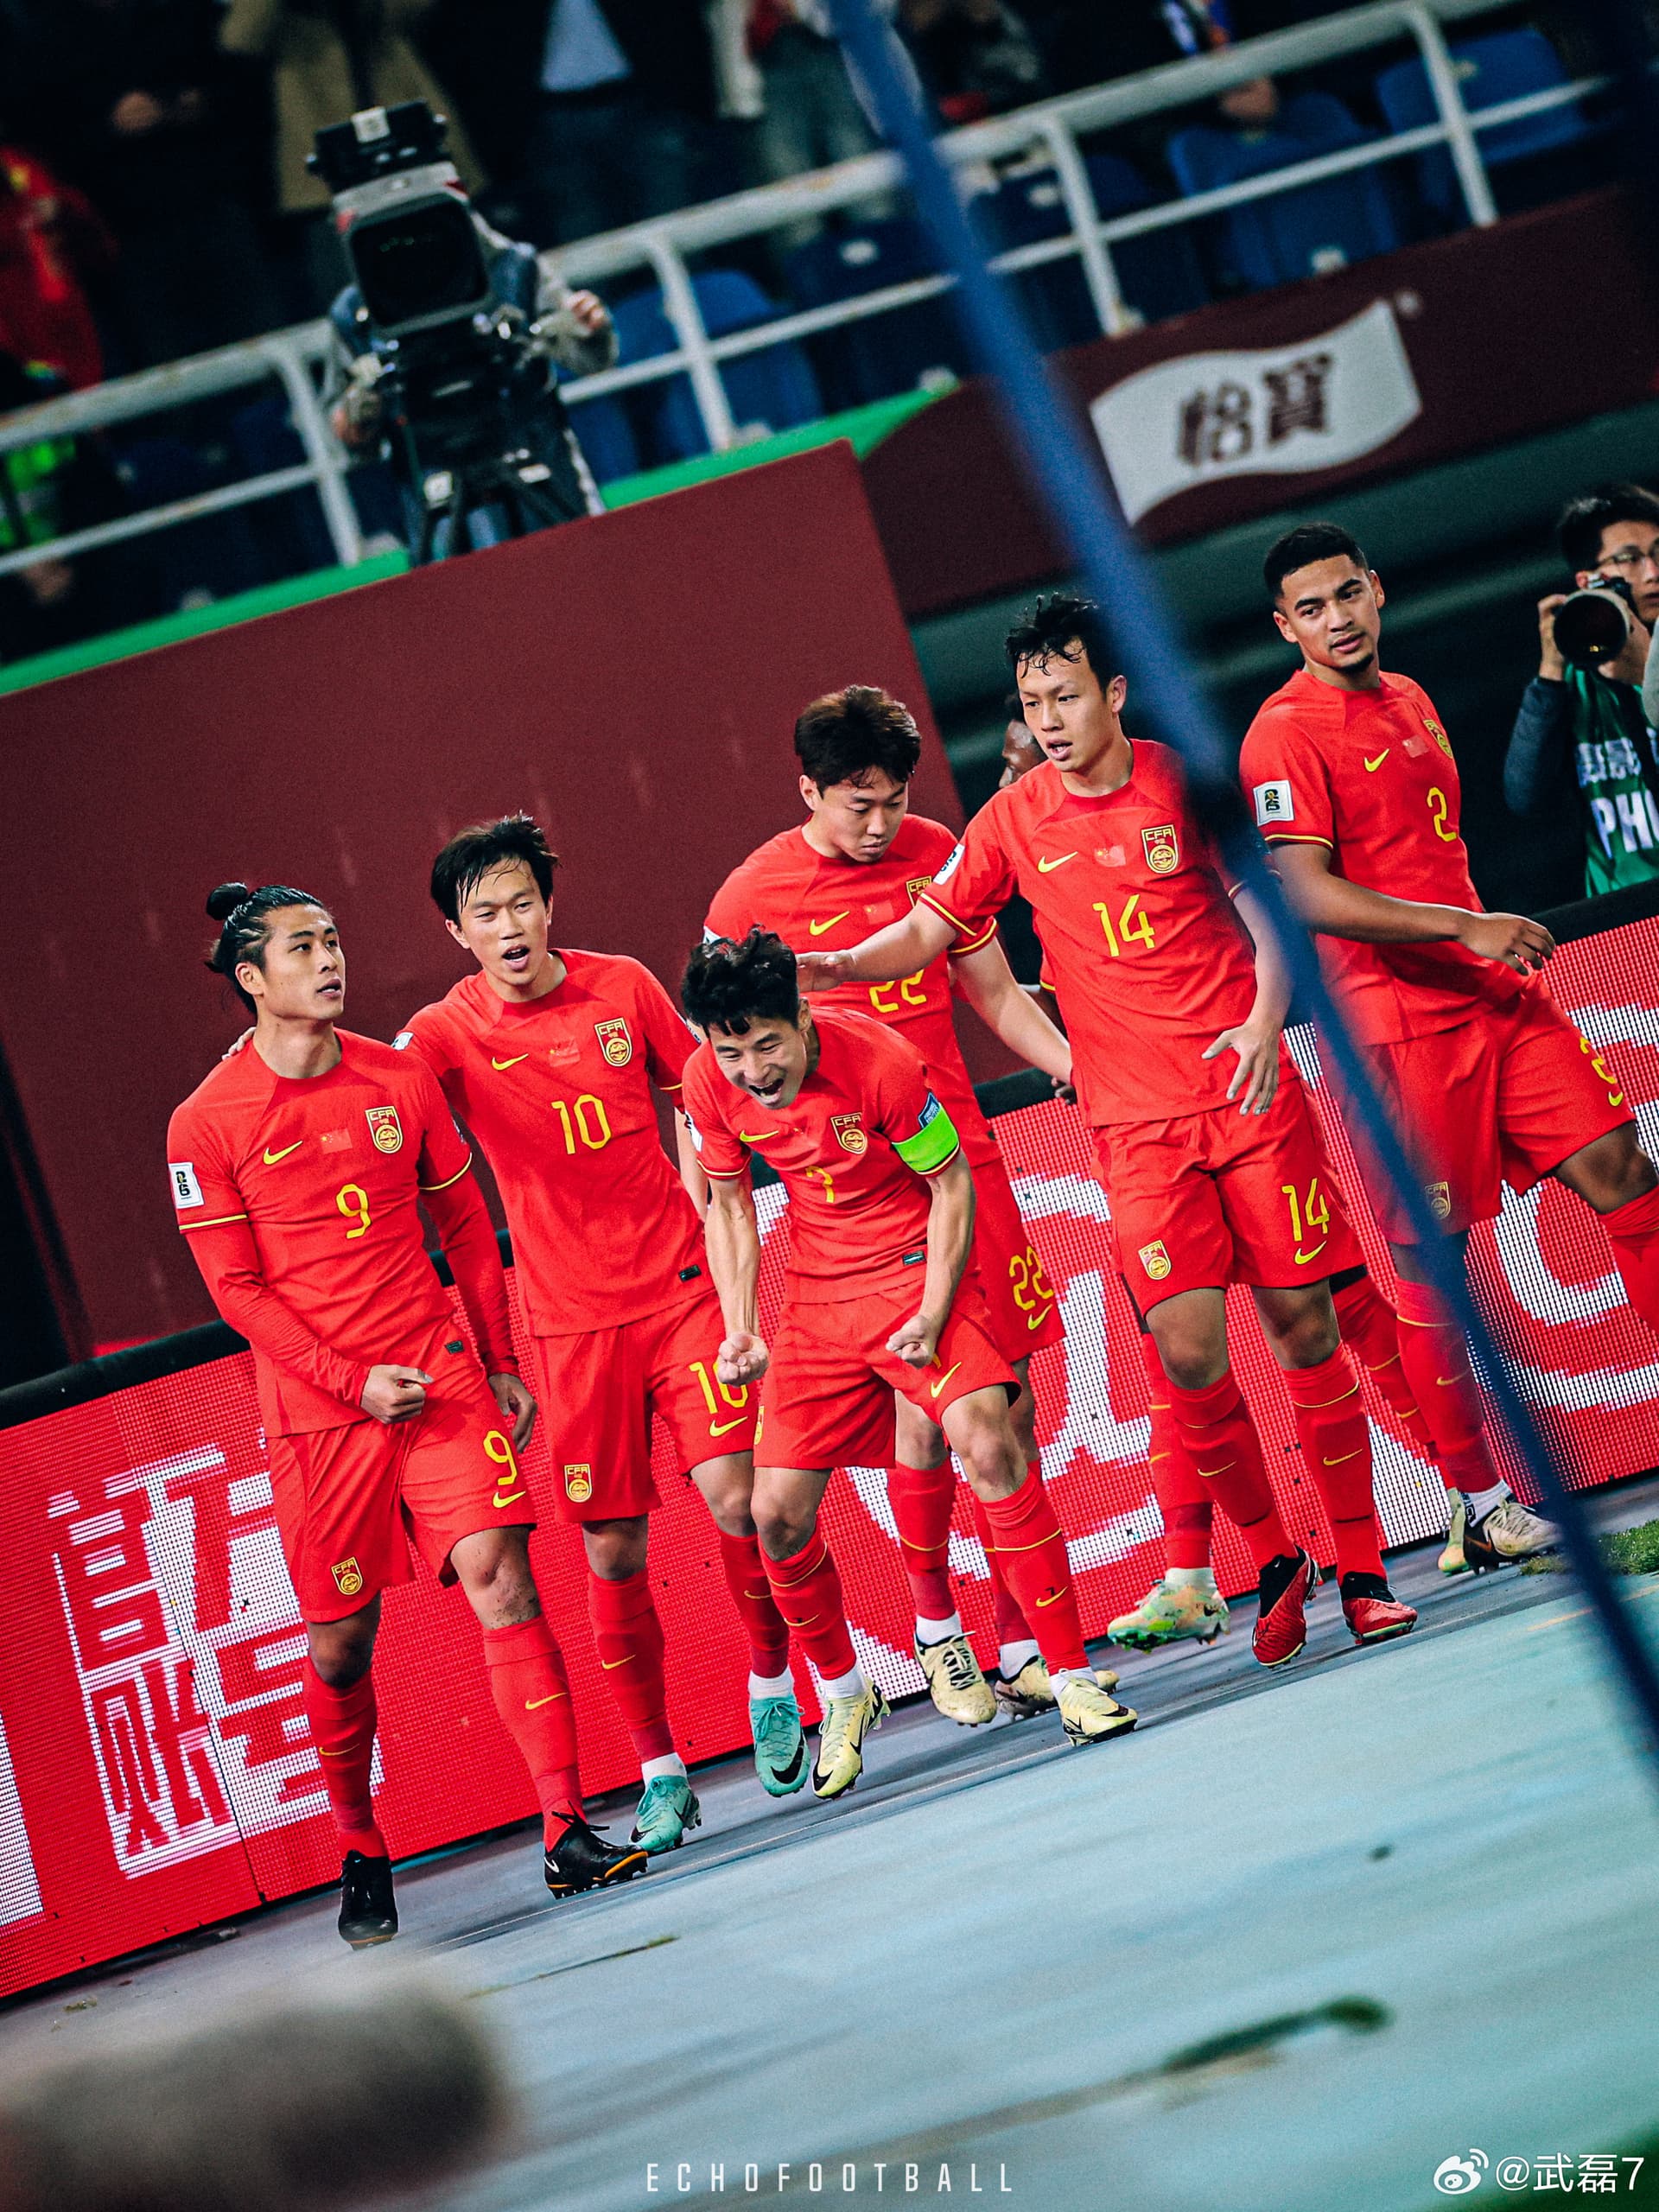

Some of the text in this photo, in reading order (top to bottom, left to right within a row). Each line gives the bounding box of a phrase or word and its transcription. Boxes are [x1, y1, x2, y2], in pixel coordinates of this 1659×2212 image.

[1427, 786, 1458, 842] 2
[1146, 828, 1173, 842] CFA
[1092, 893, 1155, 957] 14
[598, 1023, 623, 1035] CFA
[369, 1109, 395, 1122] CFA
[550, 1094, 613, 1155] 10
[835, 1115, 861, 1127] CFA
[805, 1166, 833, 1204] 7
[335, 1183, 372, 1240] 9
[1281, 1178, 1330, 1242] 14
[1141, 1244, 1162, 1257] CFA
[1009, 1245, 1055, 1311] 22
[483, 1430, 518, 1486] 9
[566, 1466, 588, 1476] CFA
[334, 1561, 355, 1575] CFA
